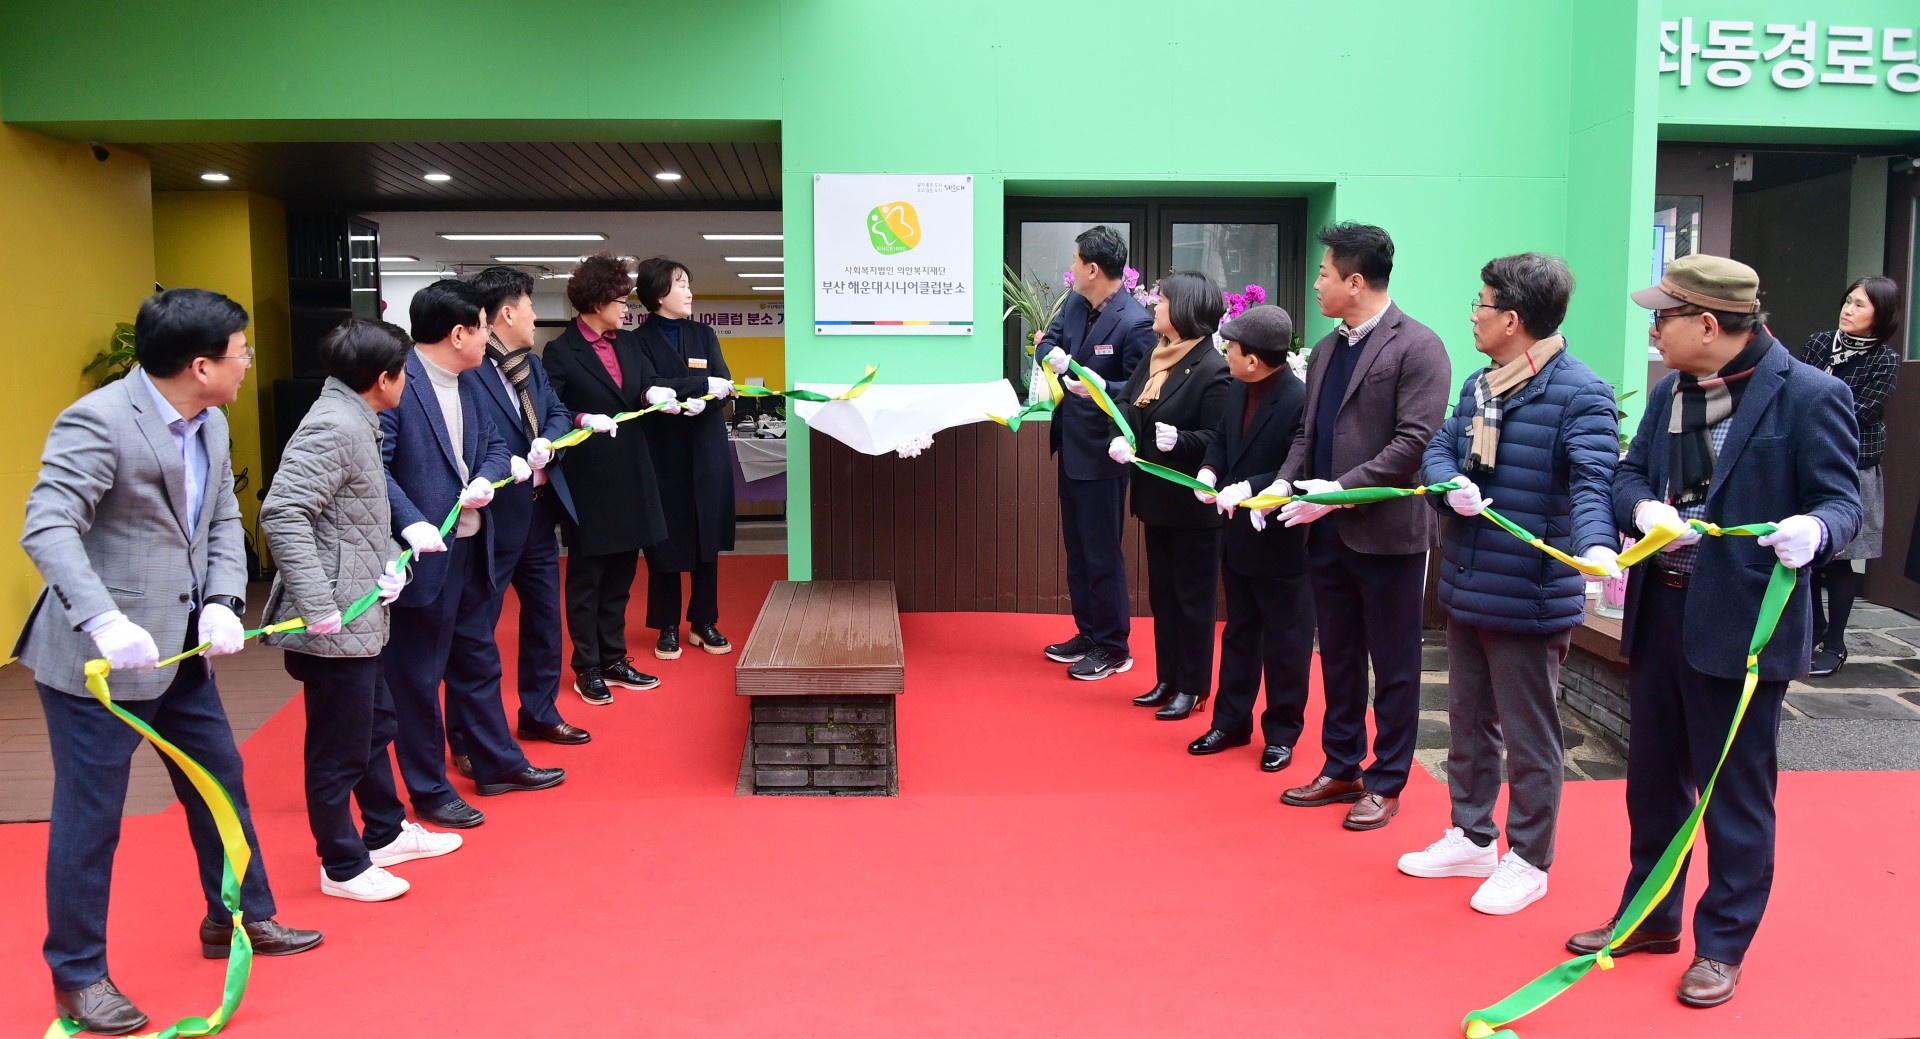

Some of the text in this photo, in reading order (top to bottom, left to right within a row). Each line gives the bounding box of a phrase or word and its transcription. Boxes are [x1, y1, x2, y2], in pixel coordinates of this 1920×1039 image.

[845, 266, 946, 276] 사회복지법인 의안복지재단
[822, 281, 846, 295] 부산
[747, 312, 773, 326] 분소
